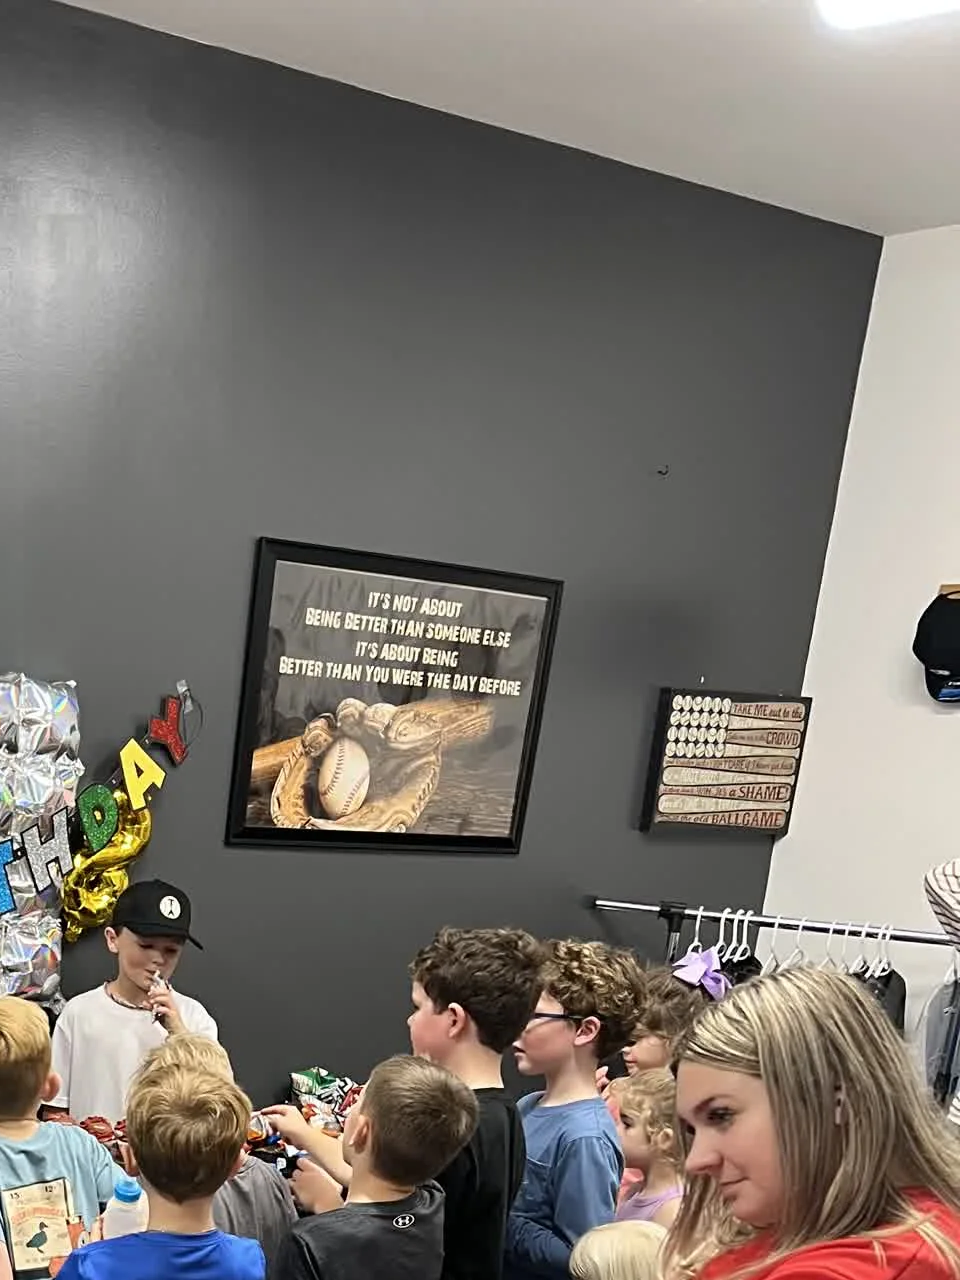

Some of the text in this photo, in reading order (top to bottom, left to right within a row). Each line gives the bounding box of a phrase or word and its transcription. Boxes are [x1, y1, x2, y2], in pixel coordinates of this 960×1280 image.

[368, 591, 463, 618] IT'S NOT ABOUT
[305, 607, 512, 648] BEING BETTER THAN SOMEONE ELSE
[355, 641, 459, 667] IT'S ABOUT BEING
[279, 655, 521, 696] BETTER THAN YOU WERE THE DAY BEFORE
[754, 704, 768, 717] ME
[766, 731, 799, 746] CROWD
[711, 812, 784, 828] BALLGAME
